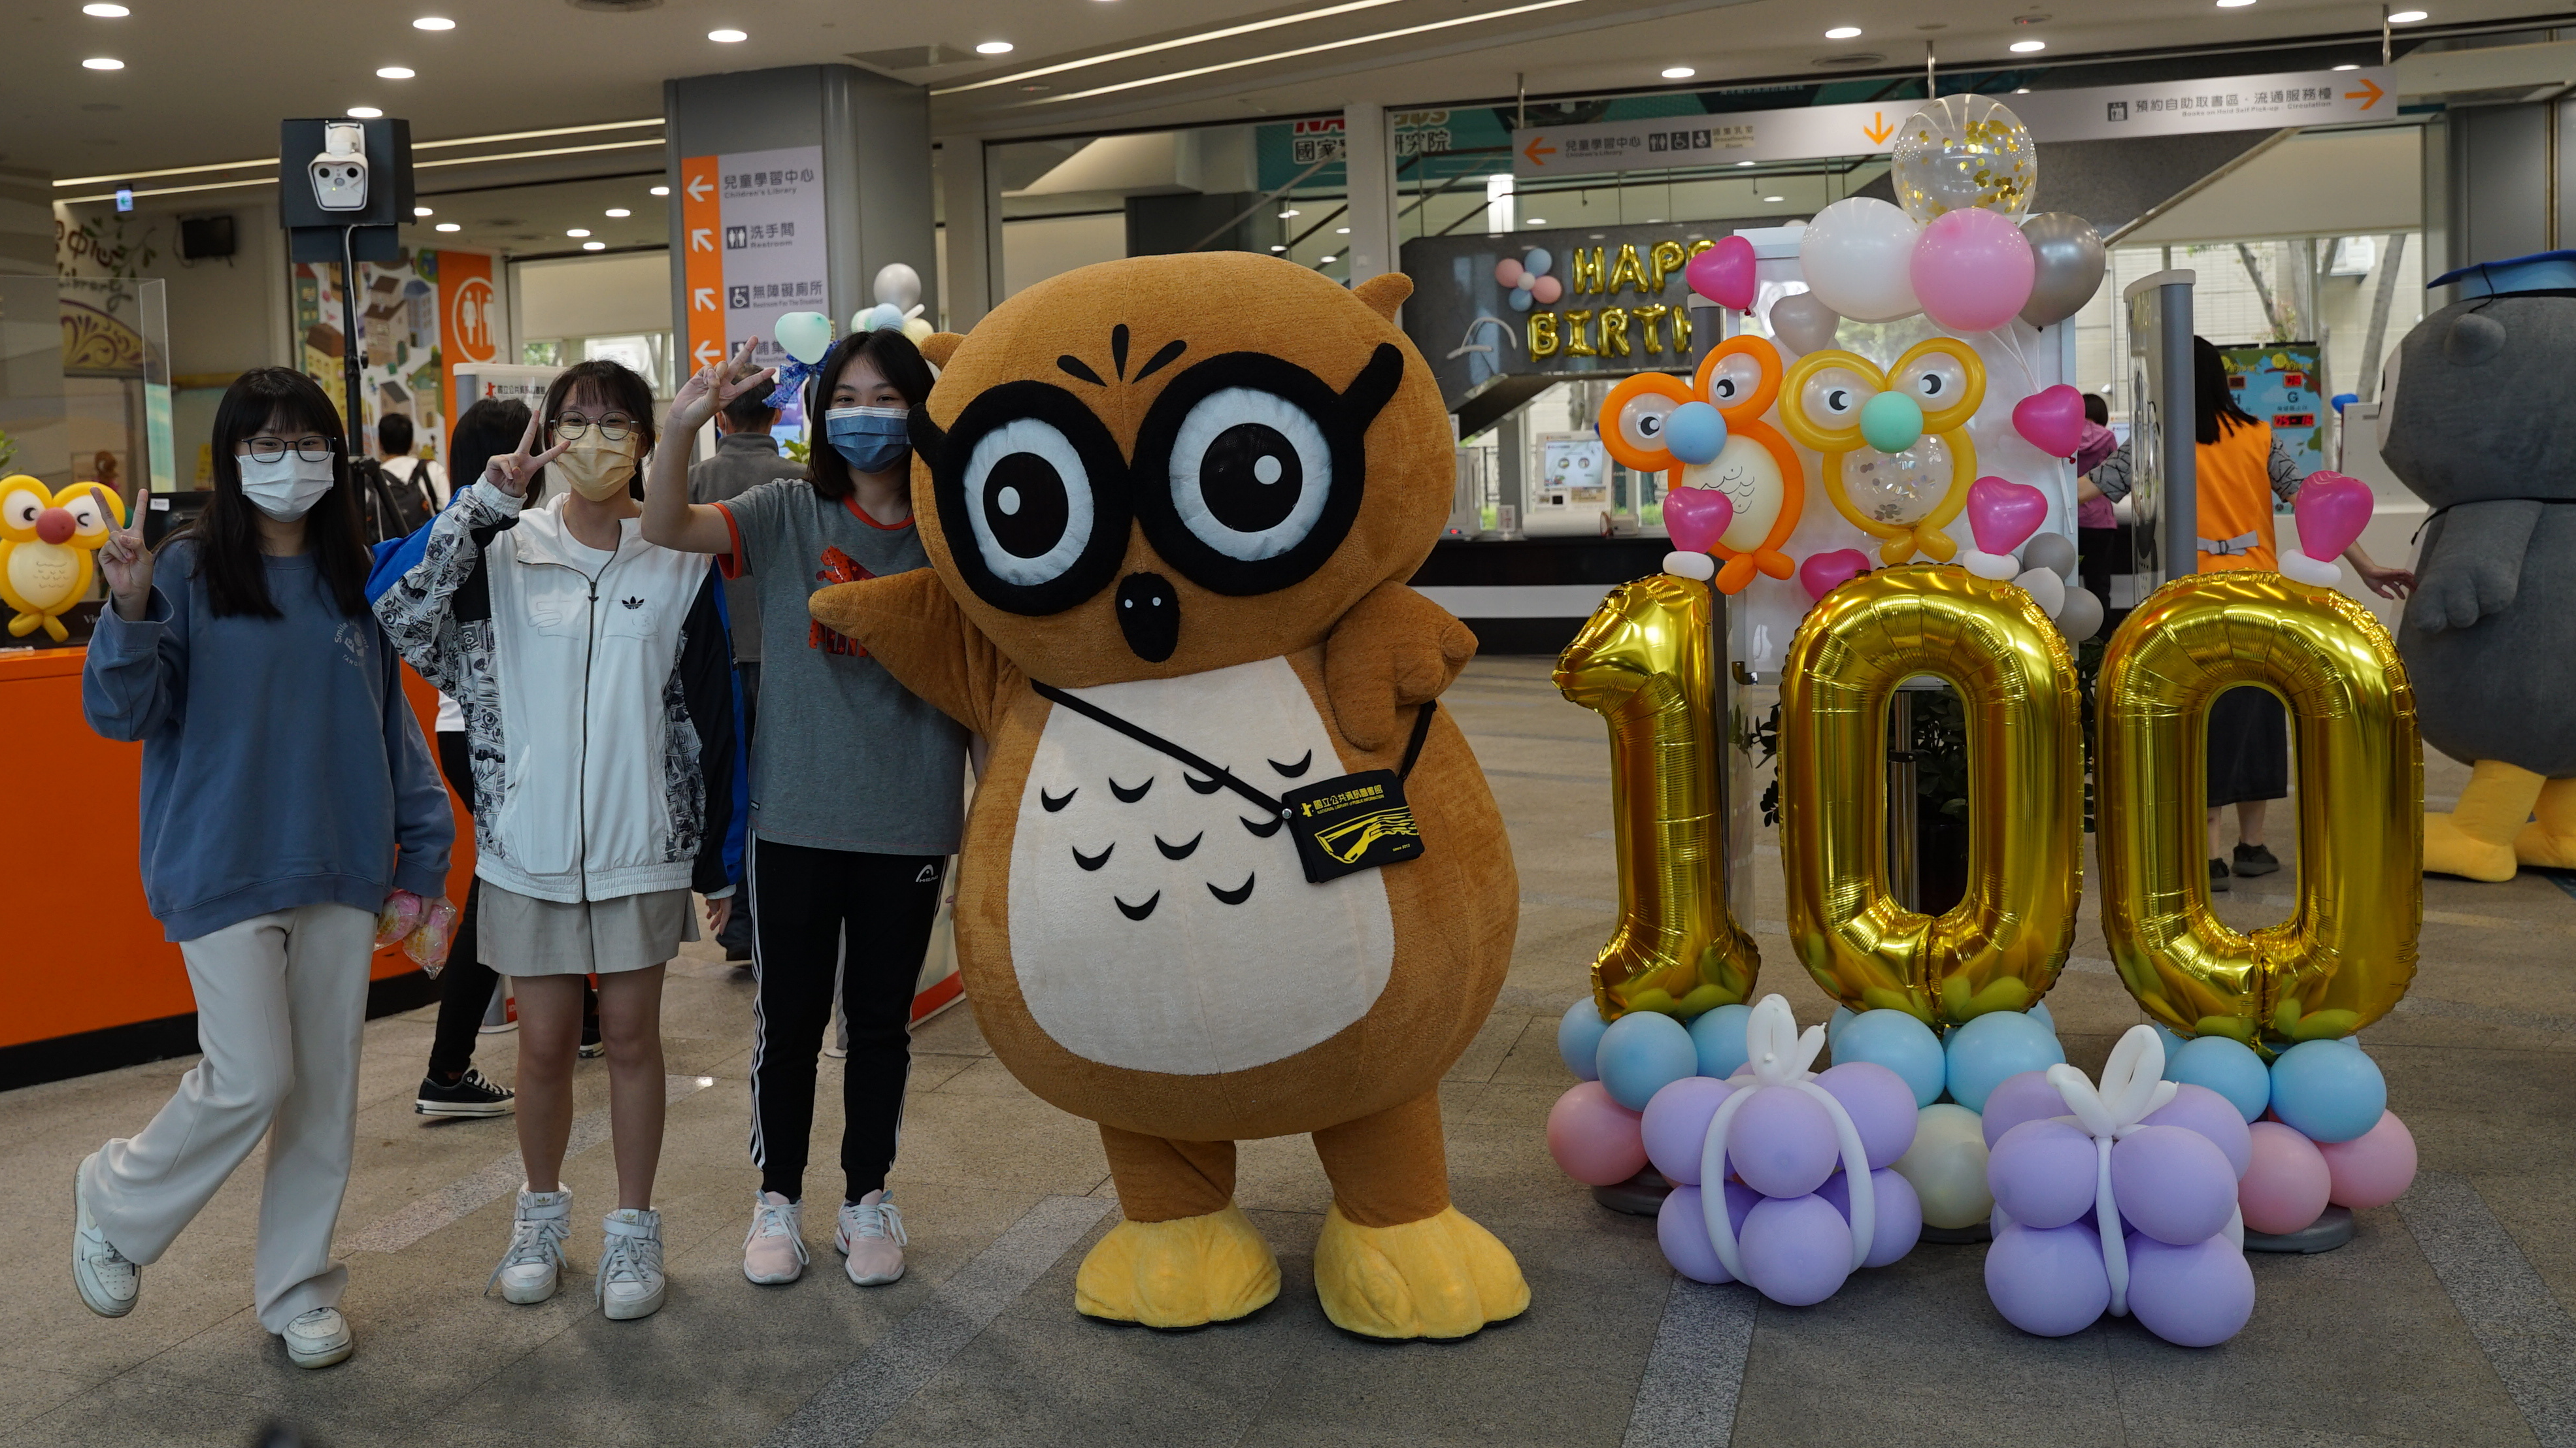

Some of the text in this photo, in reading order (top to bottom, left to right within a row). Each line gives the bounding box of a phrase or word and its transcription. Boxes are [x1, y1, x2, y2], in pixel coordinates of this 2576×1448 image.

[2287, 101, 2332, 110] Circulation
[1565, 136, 1641, 152] 兒童學習中心
[724, 167, 815, 190] 兒童學習中心
[724, 187, 797, 199] Children's Library
[750, 222, 795, 240] 洗手間
[750, 239, 793, 249] Restroom
[752, 280, 823, 299] 無障礙廁所
[334, 622, 349, 644] Smile
